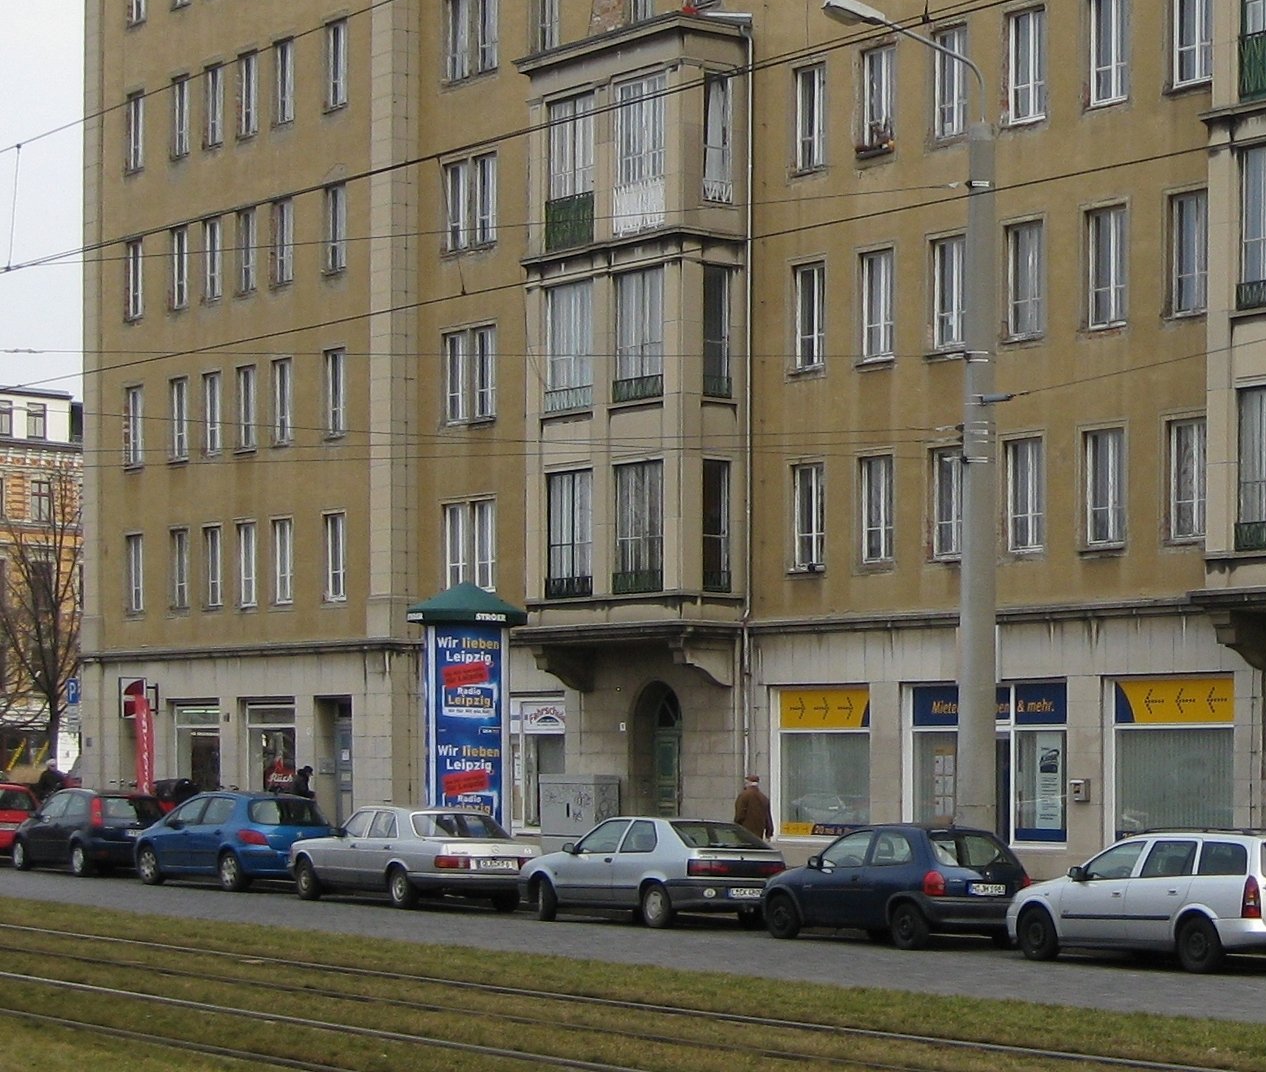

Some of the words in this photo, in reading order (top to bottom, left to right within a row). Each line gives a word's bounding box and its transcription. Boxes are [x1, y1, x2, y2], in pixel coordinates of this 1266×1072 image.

[437, 636, 459, 648] Wir
[462, 637, 499, 649] lieben
[446, 650, 491, 666] Leipzig
[69, 682, 76, 701] P
[457, 687, 481, 695] Radio
[448, 695, 491, 708] Leipzig
[1017, 699, 1025, 713] &
[438, 744, 459, 756] Wir
[462, 745, 500, 757] lieben
[446, 758, 492, 774] Leipzig
[457, 794, 481, 803] Radio
